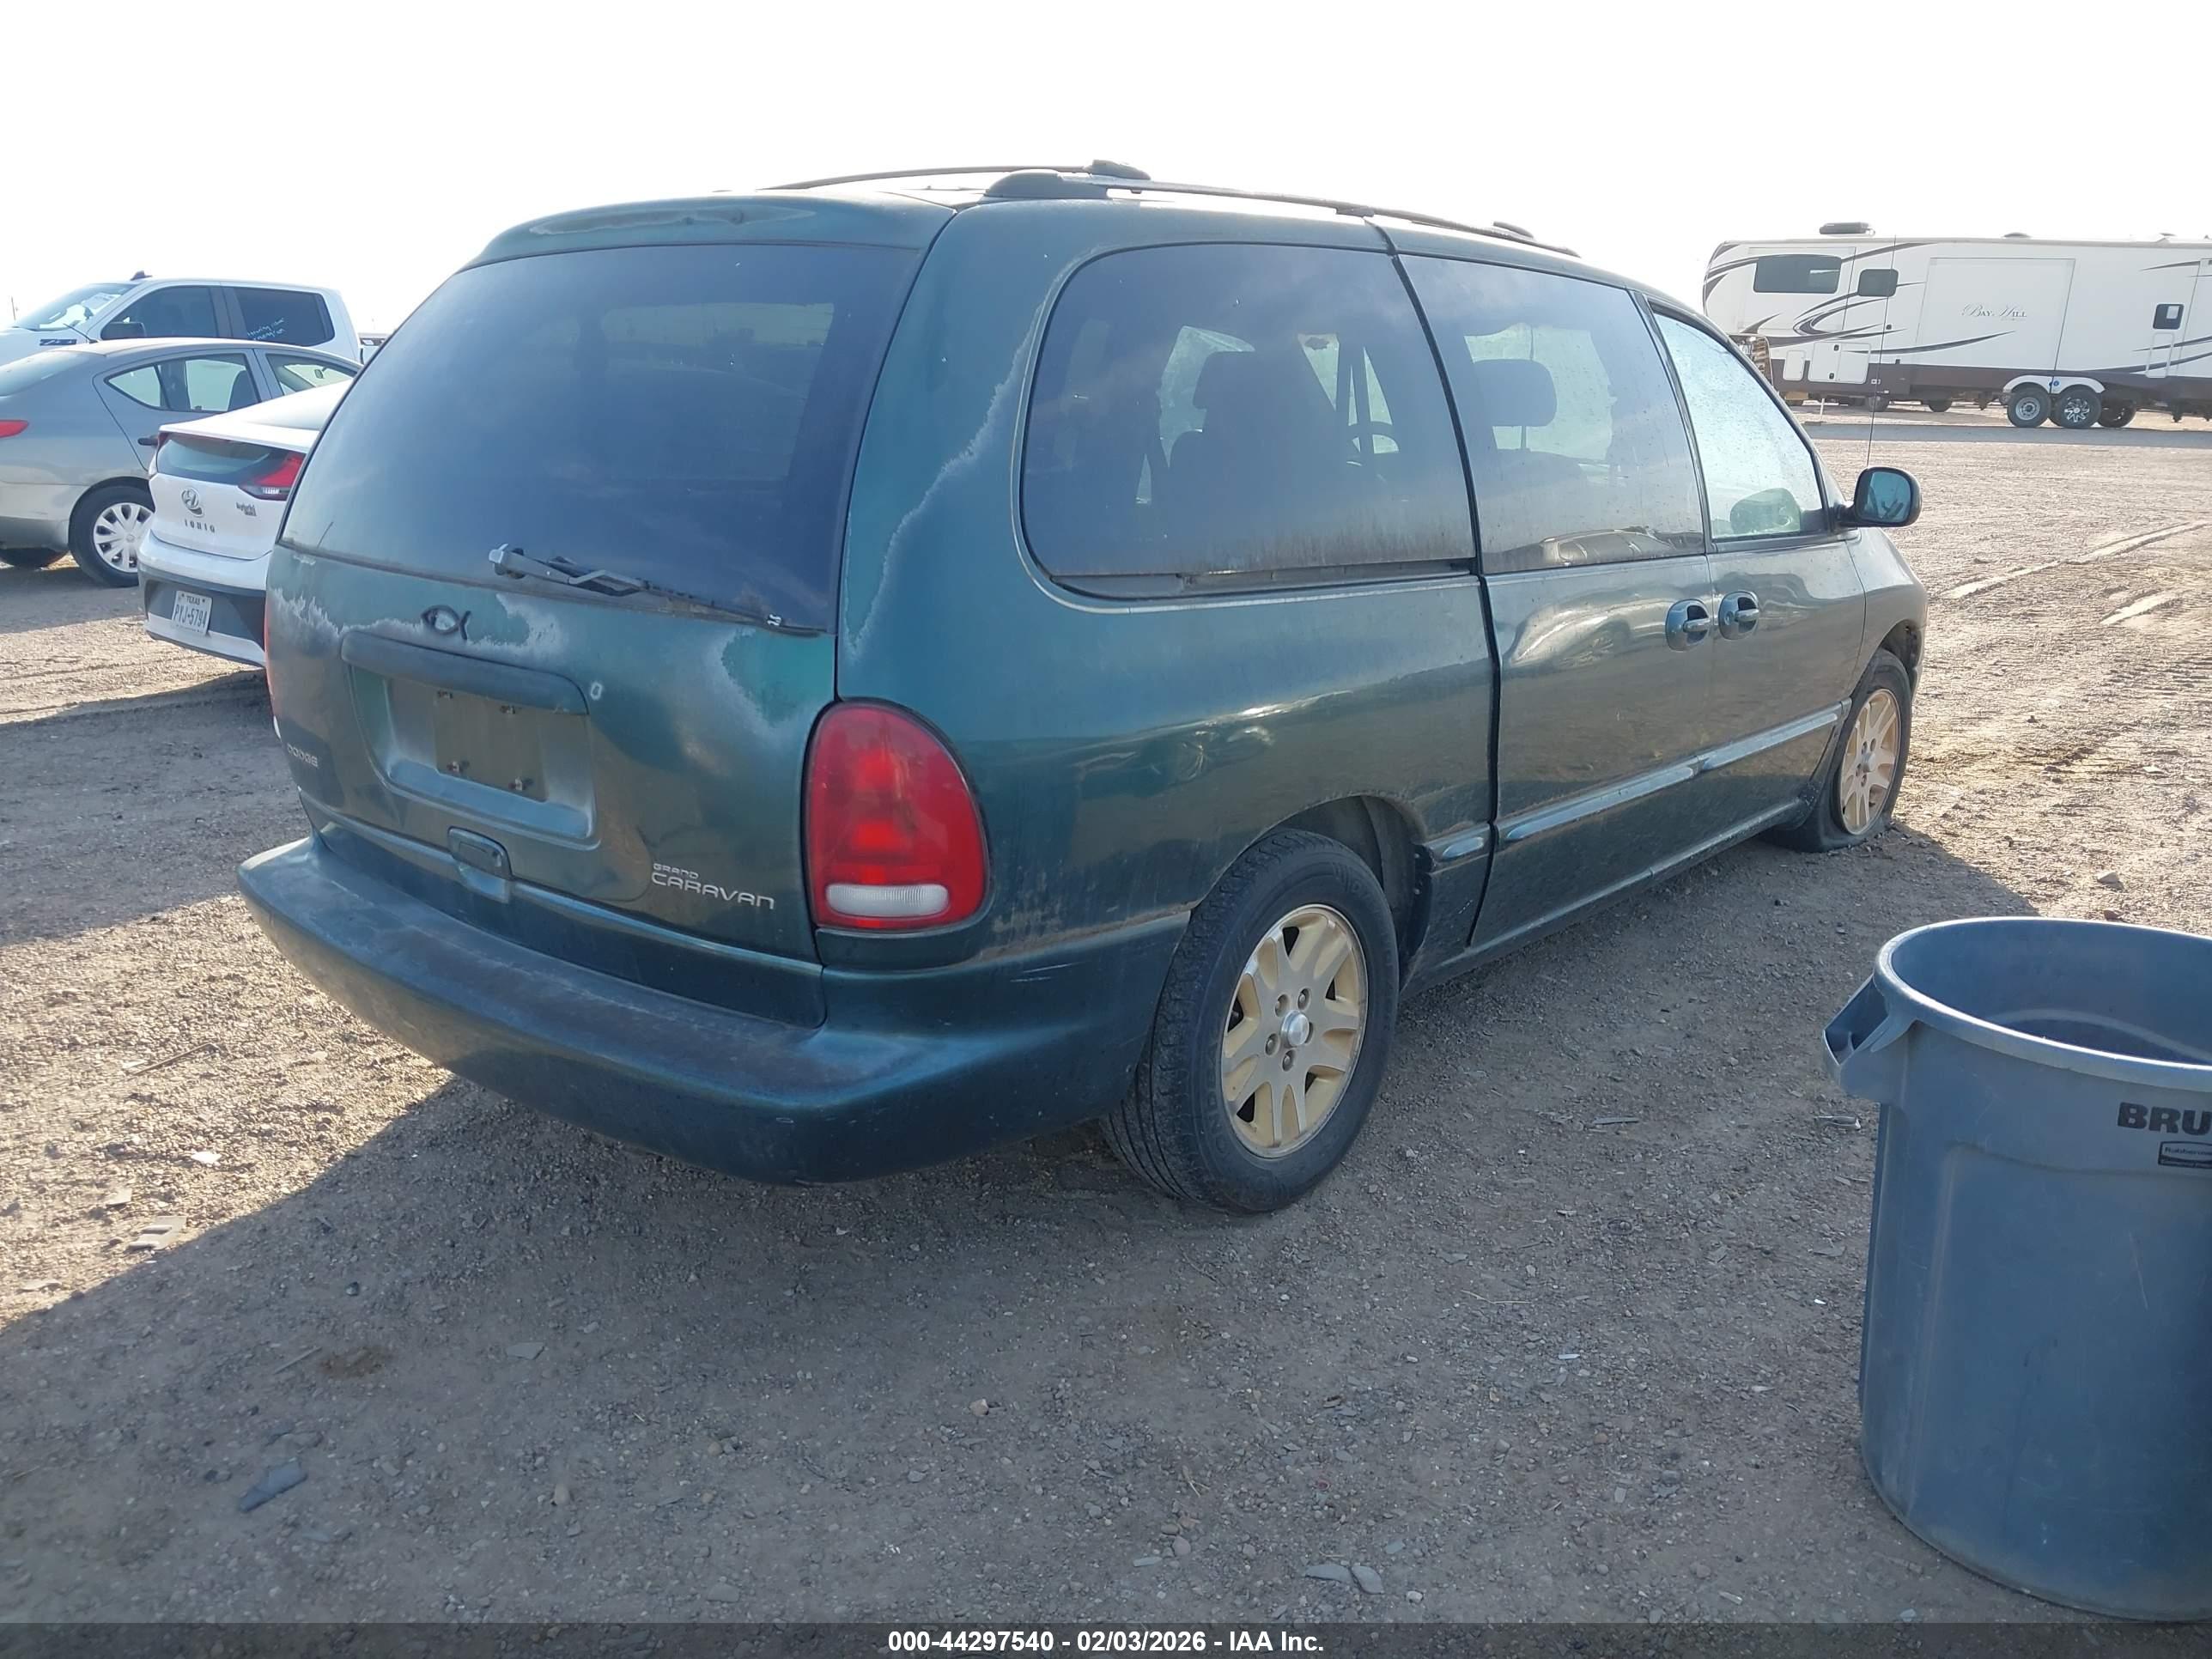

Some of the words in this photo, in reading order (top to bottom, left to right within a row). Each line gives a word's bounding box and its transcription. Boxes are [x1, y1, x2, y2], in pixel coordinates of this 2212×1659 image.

[185, 595, 201, 605] TEXAS
[287, 742, 319, 768] DODGE
[653, 862, 700, 879] GRAND
[651, 872, 775, 910] CARAVAN
[2117, 1102, 2212, 1136] BRU
